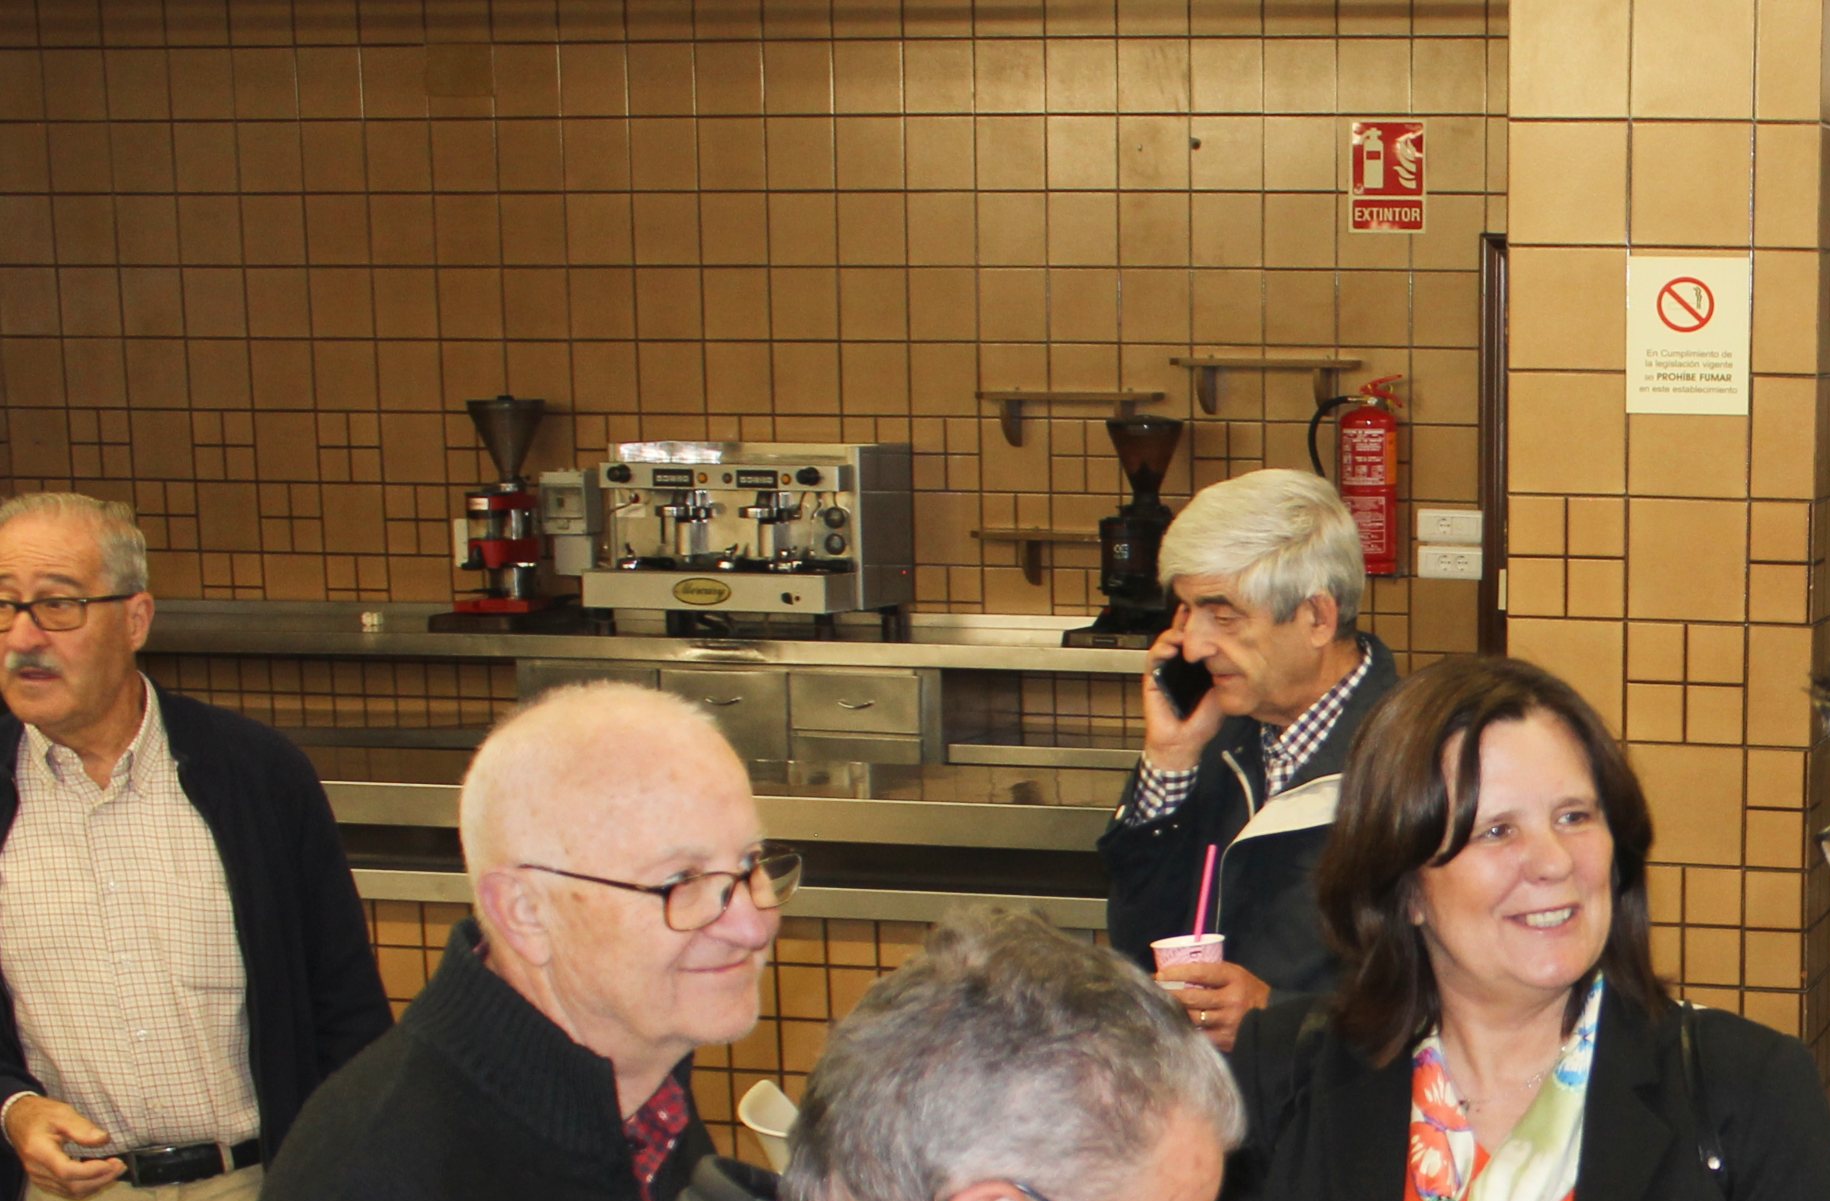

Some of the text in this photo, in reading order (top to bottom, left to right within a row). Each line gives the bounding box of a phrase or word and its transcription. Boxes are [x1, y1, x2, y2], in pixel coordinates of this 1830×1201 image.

[1354, 207, 1421, 222] EXTINTOR
[1646, 349, 1732, 359] En Cumplimiento de
[1655, 360, 1700, 369] legislación
[1702, 361, 1733, 369] vigente
[1700, 373, 1732, 382] FUMAR
[1652, 385, 1670, 393] este
[1672, 385, 1738, 394] establecimiento
